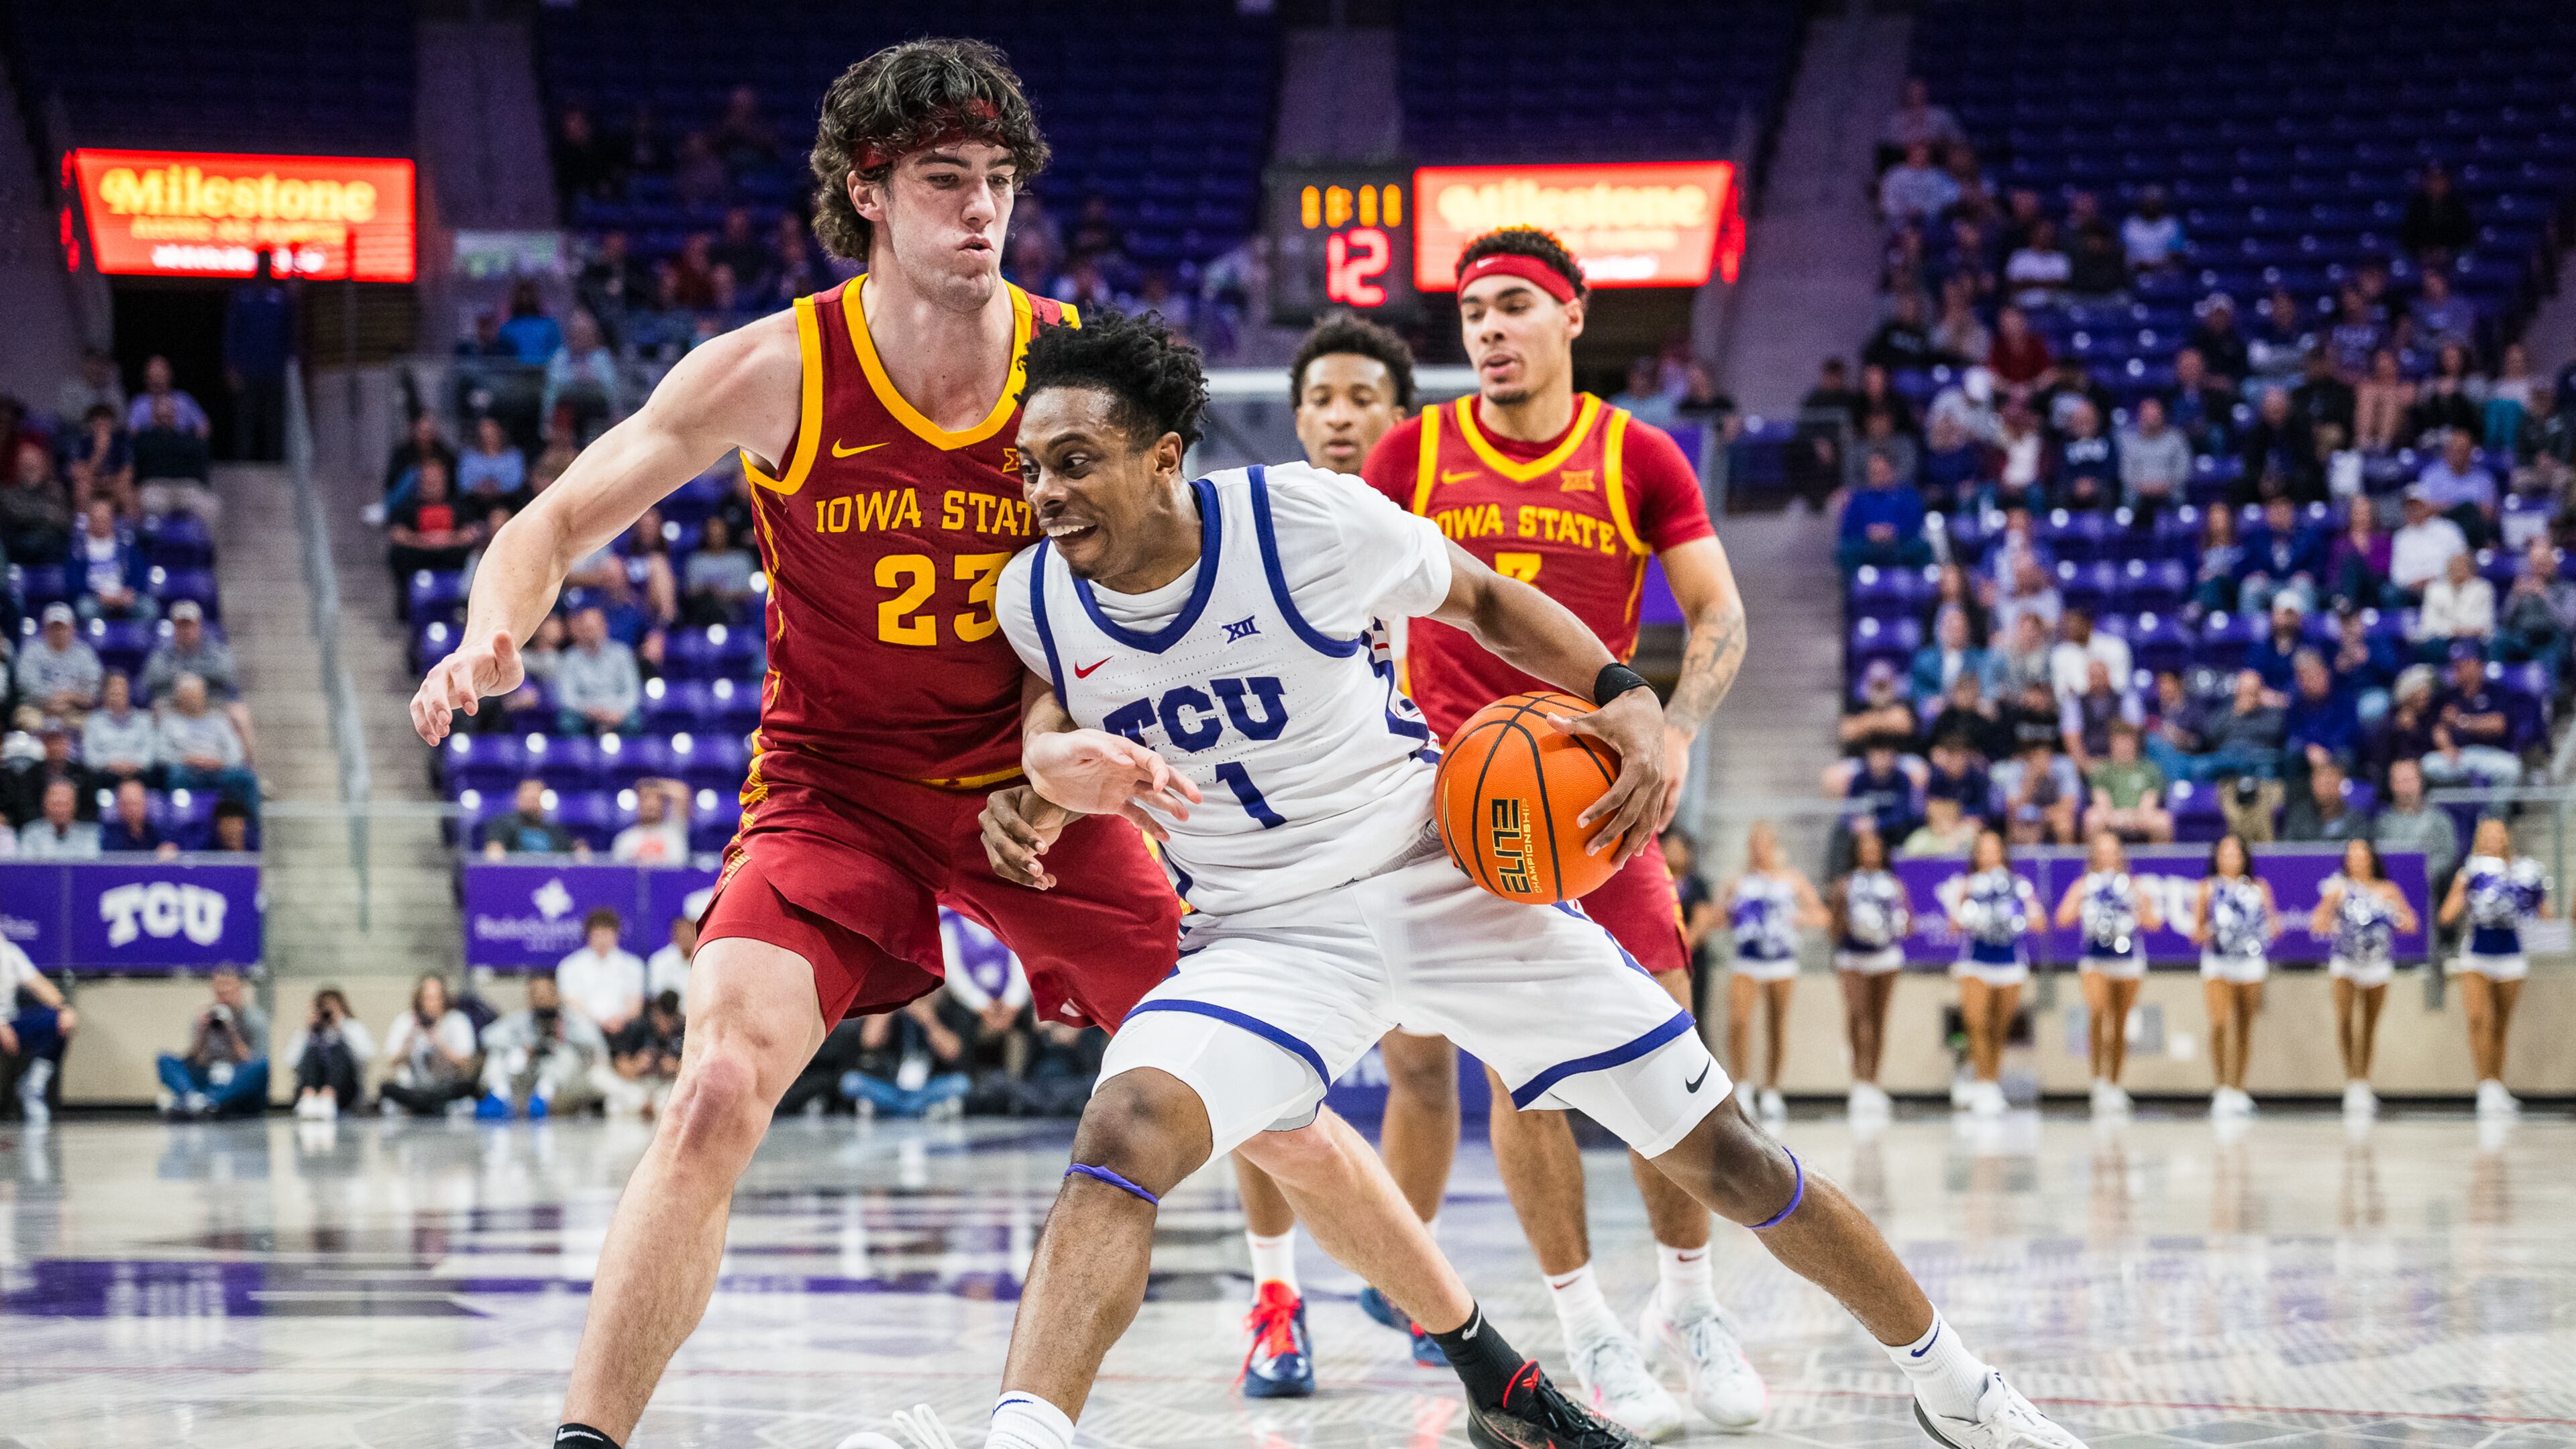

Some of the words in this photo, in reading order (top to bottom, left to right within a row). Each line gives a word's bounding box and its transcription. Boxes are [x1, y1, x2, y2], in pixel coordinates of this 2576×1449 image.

[99, 164, 376, 223] Milestone
[1326, 227, 1391, 307] 12
[816, 488, 922, 533] IOWA
[942, 490, 1047, 536] STAT
[1430, 503, 1503, 540] OWA
[1518, 505, 1616, 555] STATE
[874, 551, 1012, 647] 23
[1222, 614, 1261, 645] XII
[1102, 676, 1289, 753] TCU
[1215, 761, 1288, 829] 1
[1491, 798, 1534, 894] ELITE
[1521, 797, 1544, 894] CHAMPIONSHIP
[99, 881, 227, 947] TCU
